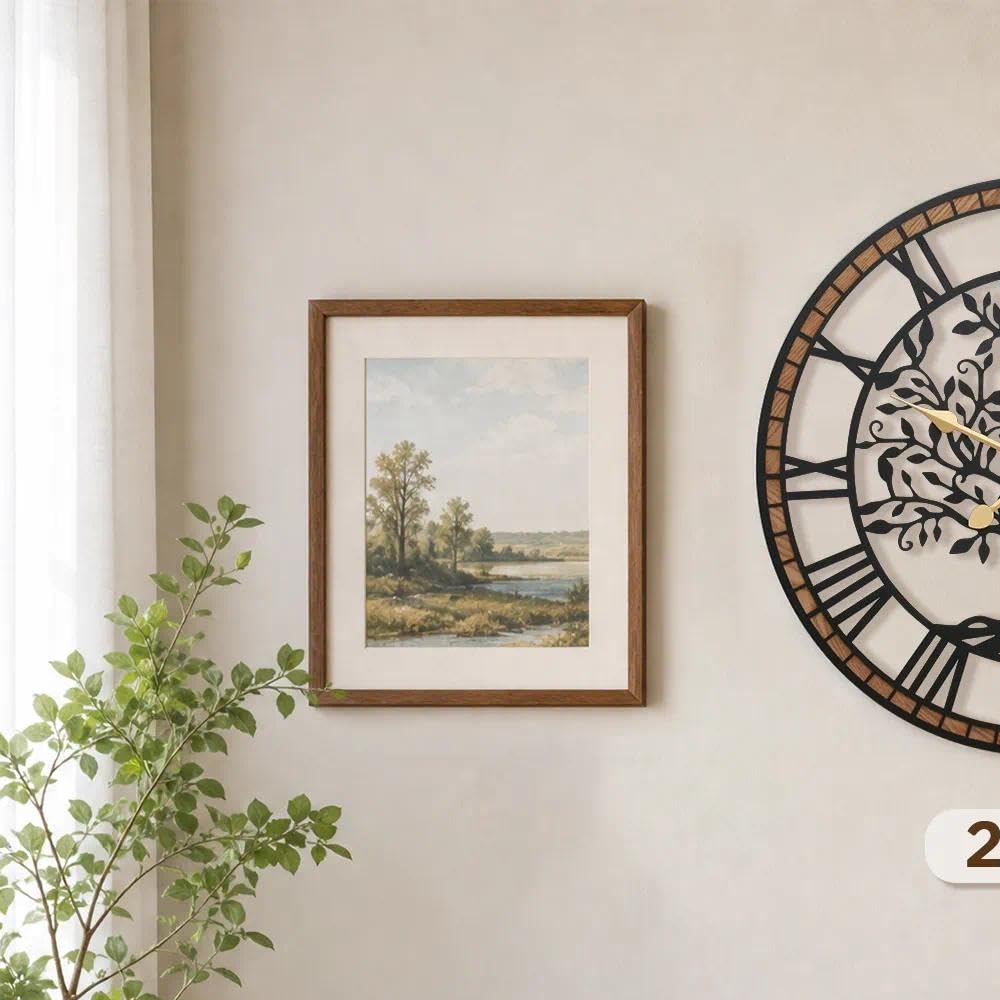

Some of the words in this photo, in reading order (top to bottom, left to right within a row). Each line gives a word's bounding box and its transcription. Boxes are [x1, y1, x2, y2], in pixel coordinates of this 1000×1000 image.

[887, 235, 953, 309] XI
[810, 334, 877, 384] X
[805, 543, 893, 643] VIII
[894, 631, 969, 713] VII
